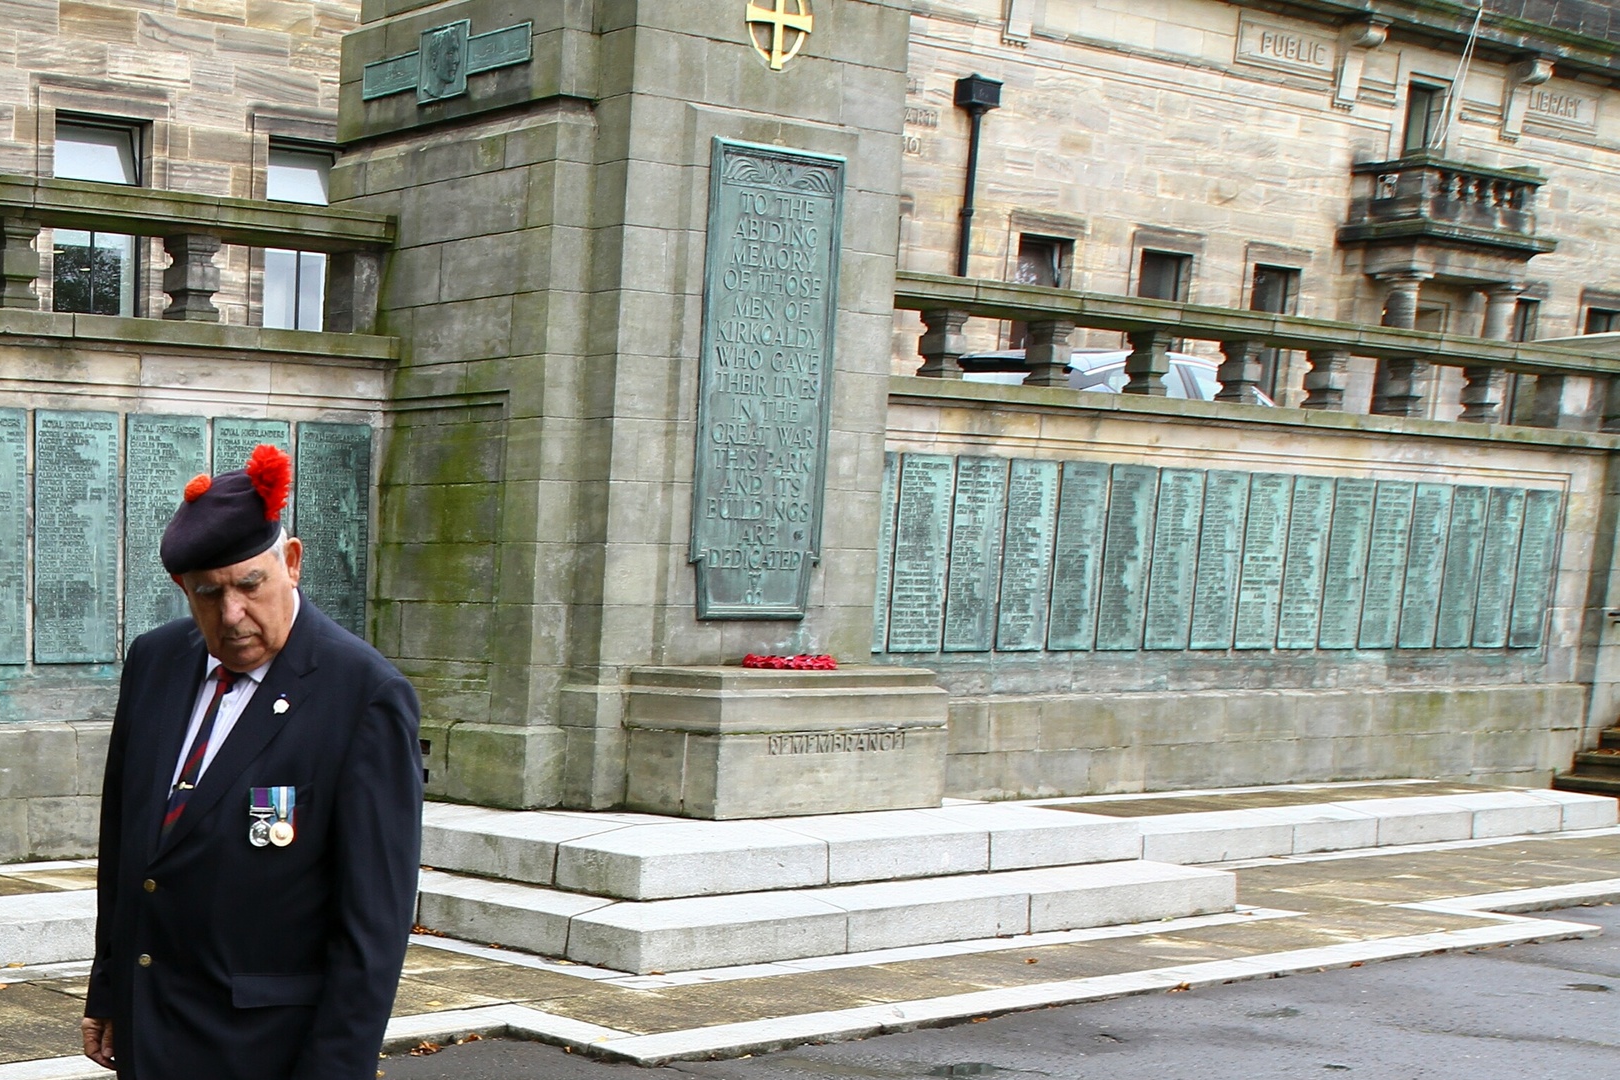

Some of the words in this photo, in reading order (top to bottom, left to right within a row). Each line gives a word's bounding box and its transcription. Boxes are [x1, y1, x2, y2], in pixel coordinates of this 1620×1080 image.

[1262, 30, 1327, 66] PUBLIC
[1529, 91, 1582, 119] LIBRARY
[741, 191, 767, 216] TO
[777, 197, 815, 222] THE
[732, 218, 818, 248] ABIDING
[730, 245, 816, 273] MEMORY
[724, 268, 750, 291] OF
[759, 272, 821, 299] THOSE
[733, 298, 776, 319] MEN
[784, 301, 810, 323] OF
[716, 320, 822, 350] KIRKCALDY
[716, 346, 763, 370] WHO
[771, 352, 819, 375] GAVE
[716, 370, 767, 397] THEIR
[773, 377, 818, 400] LIVES
[731, 399, 752, 420] IN
[762, 401, 798, 423] THE
[711, 423, 770, 447] GREAT
[777, 426, 814, 449] WAR
[714, 448, 758, 471] THIS
[764, 452, 811, 474] PARK
[720, 474, 763, 496] AND
[772, 477, 801, 498] ITS
[707, 498, 810, 523] BUILDINGS
[738, 524, 778, 546] ARE
[708, 549, 801, 571] DEDICATED
[768, 732, 905, 755] REMEMBRANCE
